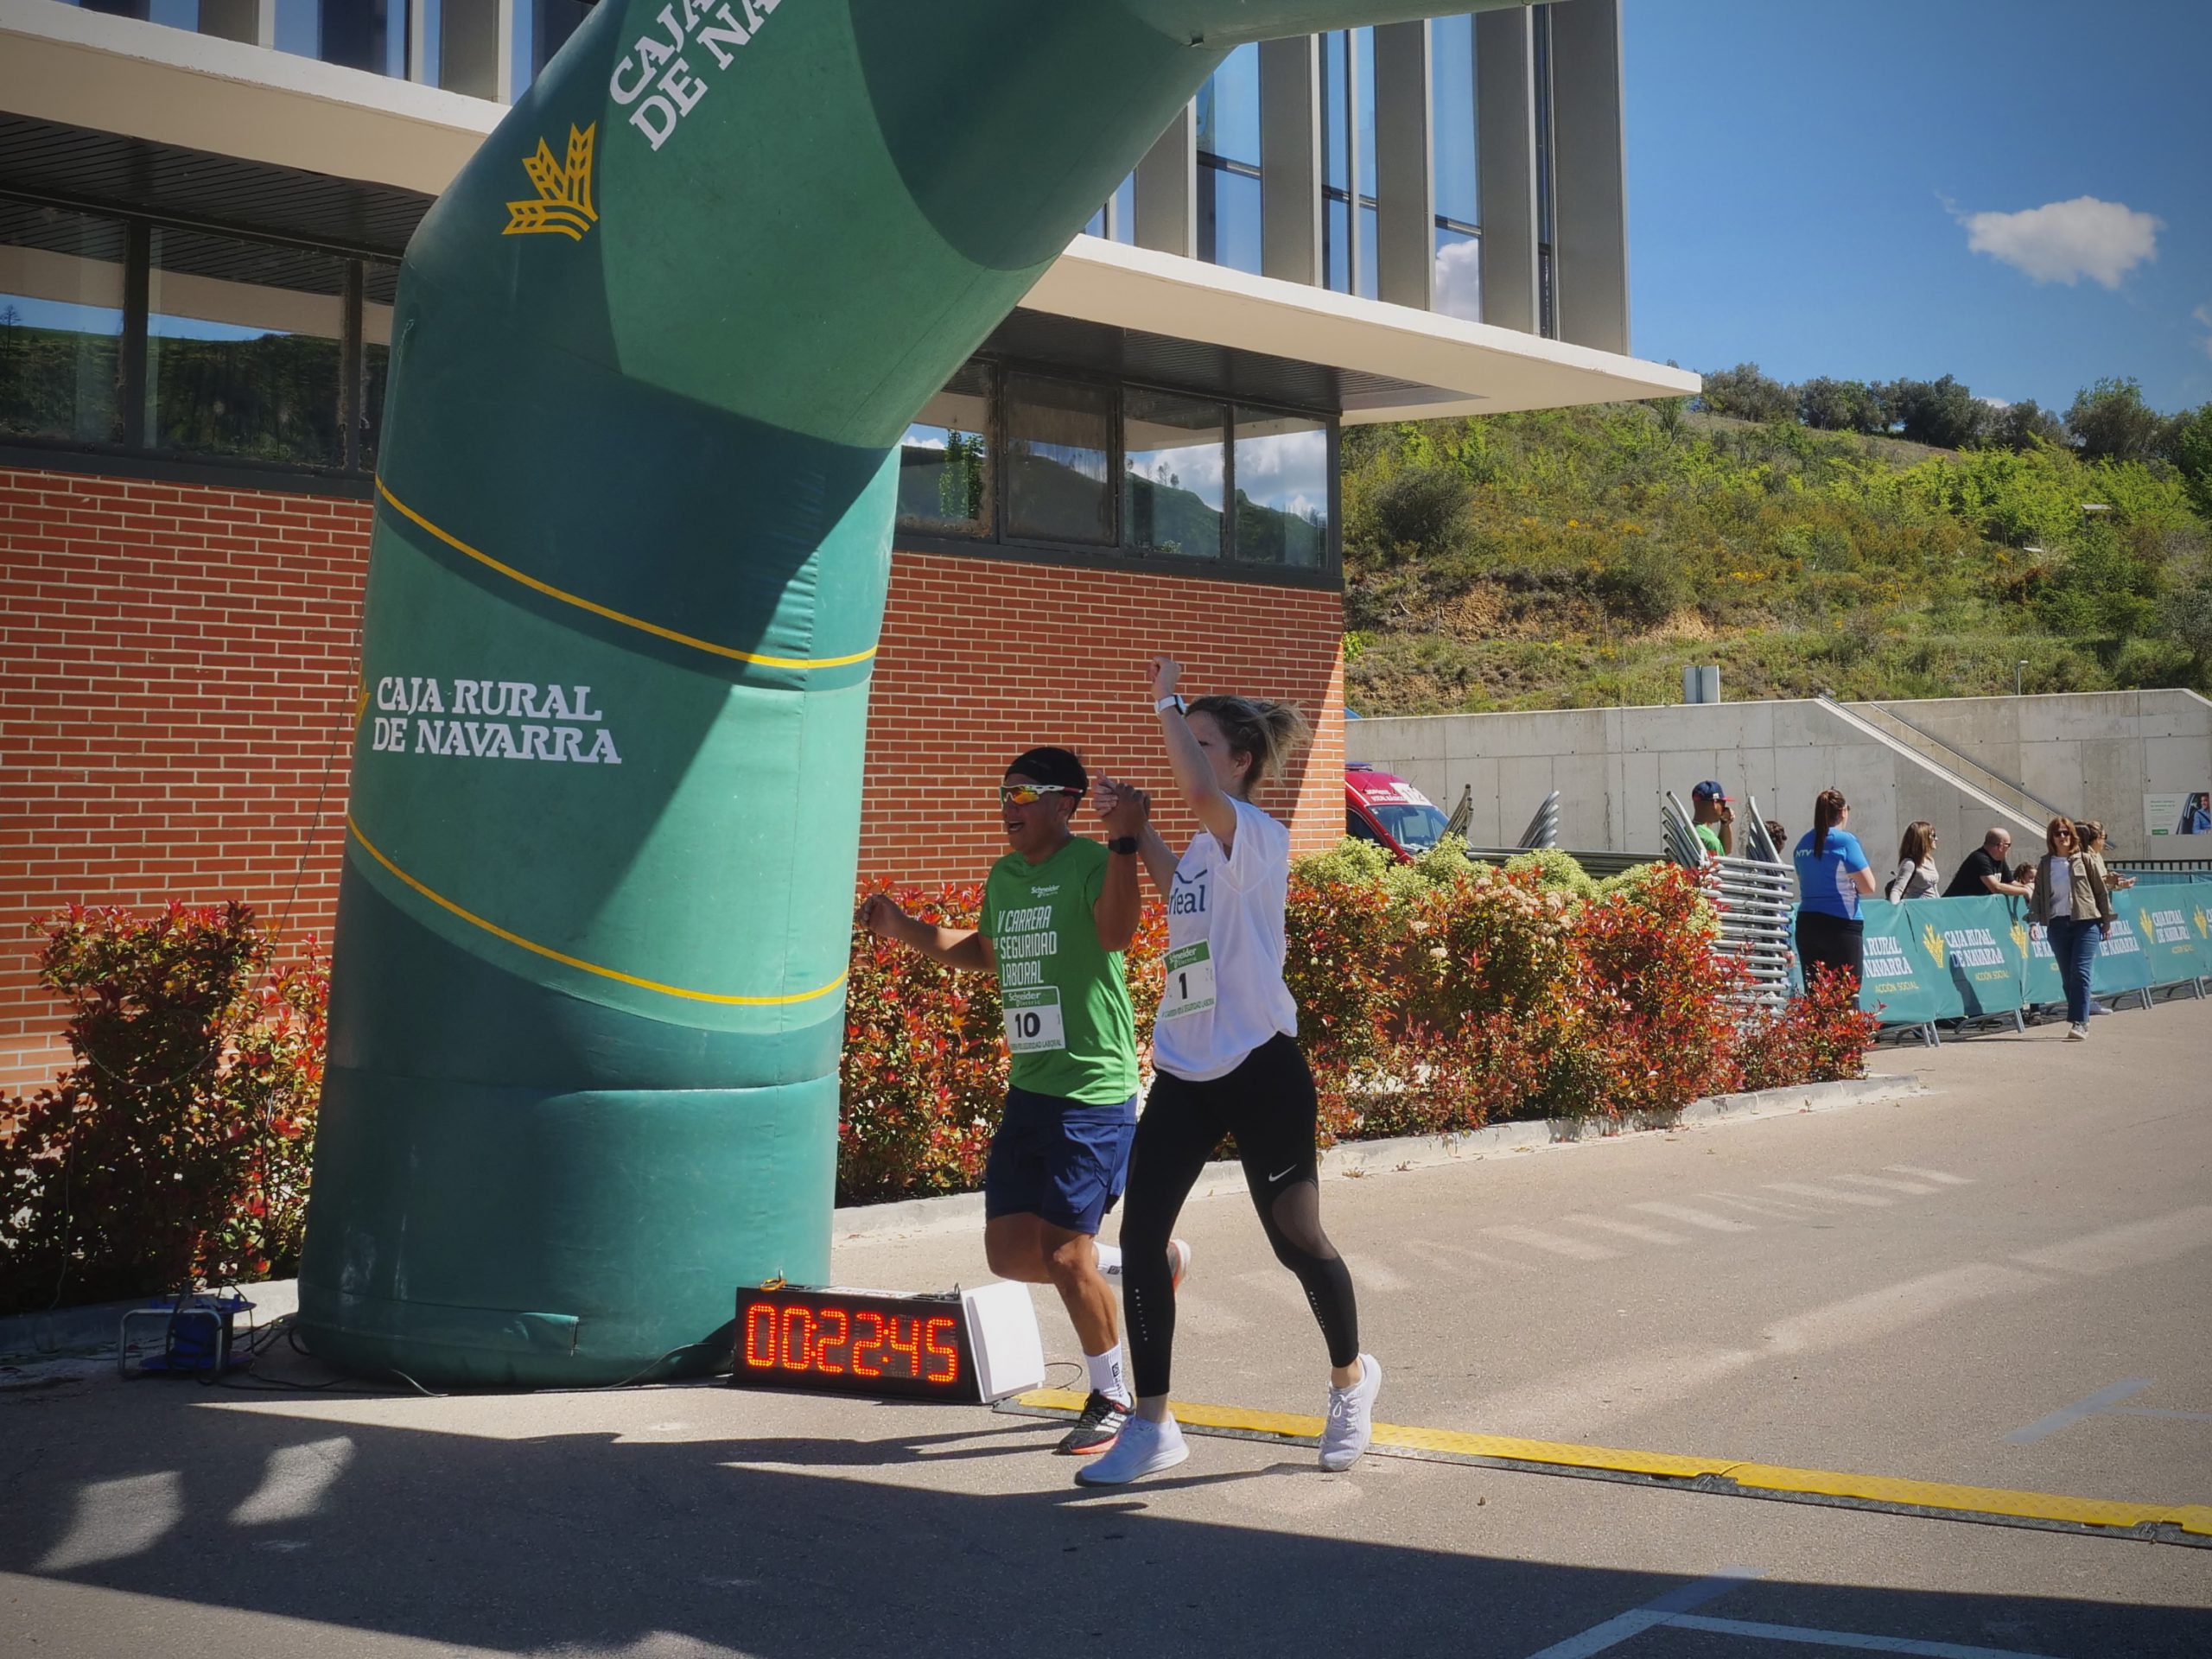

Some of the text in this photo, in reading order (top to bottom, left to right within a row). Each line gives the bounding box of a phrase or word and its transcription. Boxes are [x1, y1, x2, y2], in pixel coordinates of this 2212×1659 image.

[629, 57, 709, 151] DE
[377, 677, 602, 721] CAJA RURAL
[372, 717, 622, 764] DE NAVARRA
[1030, 885, 1060, 894] Schneider
[997, 905, 1052, 933] V CARRERA
[1000, 931, 1058, 960] SEGURIDAD
[1866, 937, 1903, 956] RURAL
[1945, 928, 1996, 949] CAJA RURAL
[1863, 957, 1913, 978] NAVARRA
[1949, 947, 2005, 968] DE NAVARRA
[1001, 960, 1044, 987] LABORAL
[1179, 972, 1187, 1000] 1
[1015, 1012, 1040, 1038] 10
[747, 1305, 955, 1382] 00:22:45
